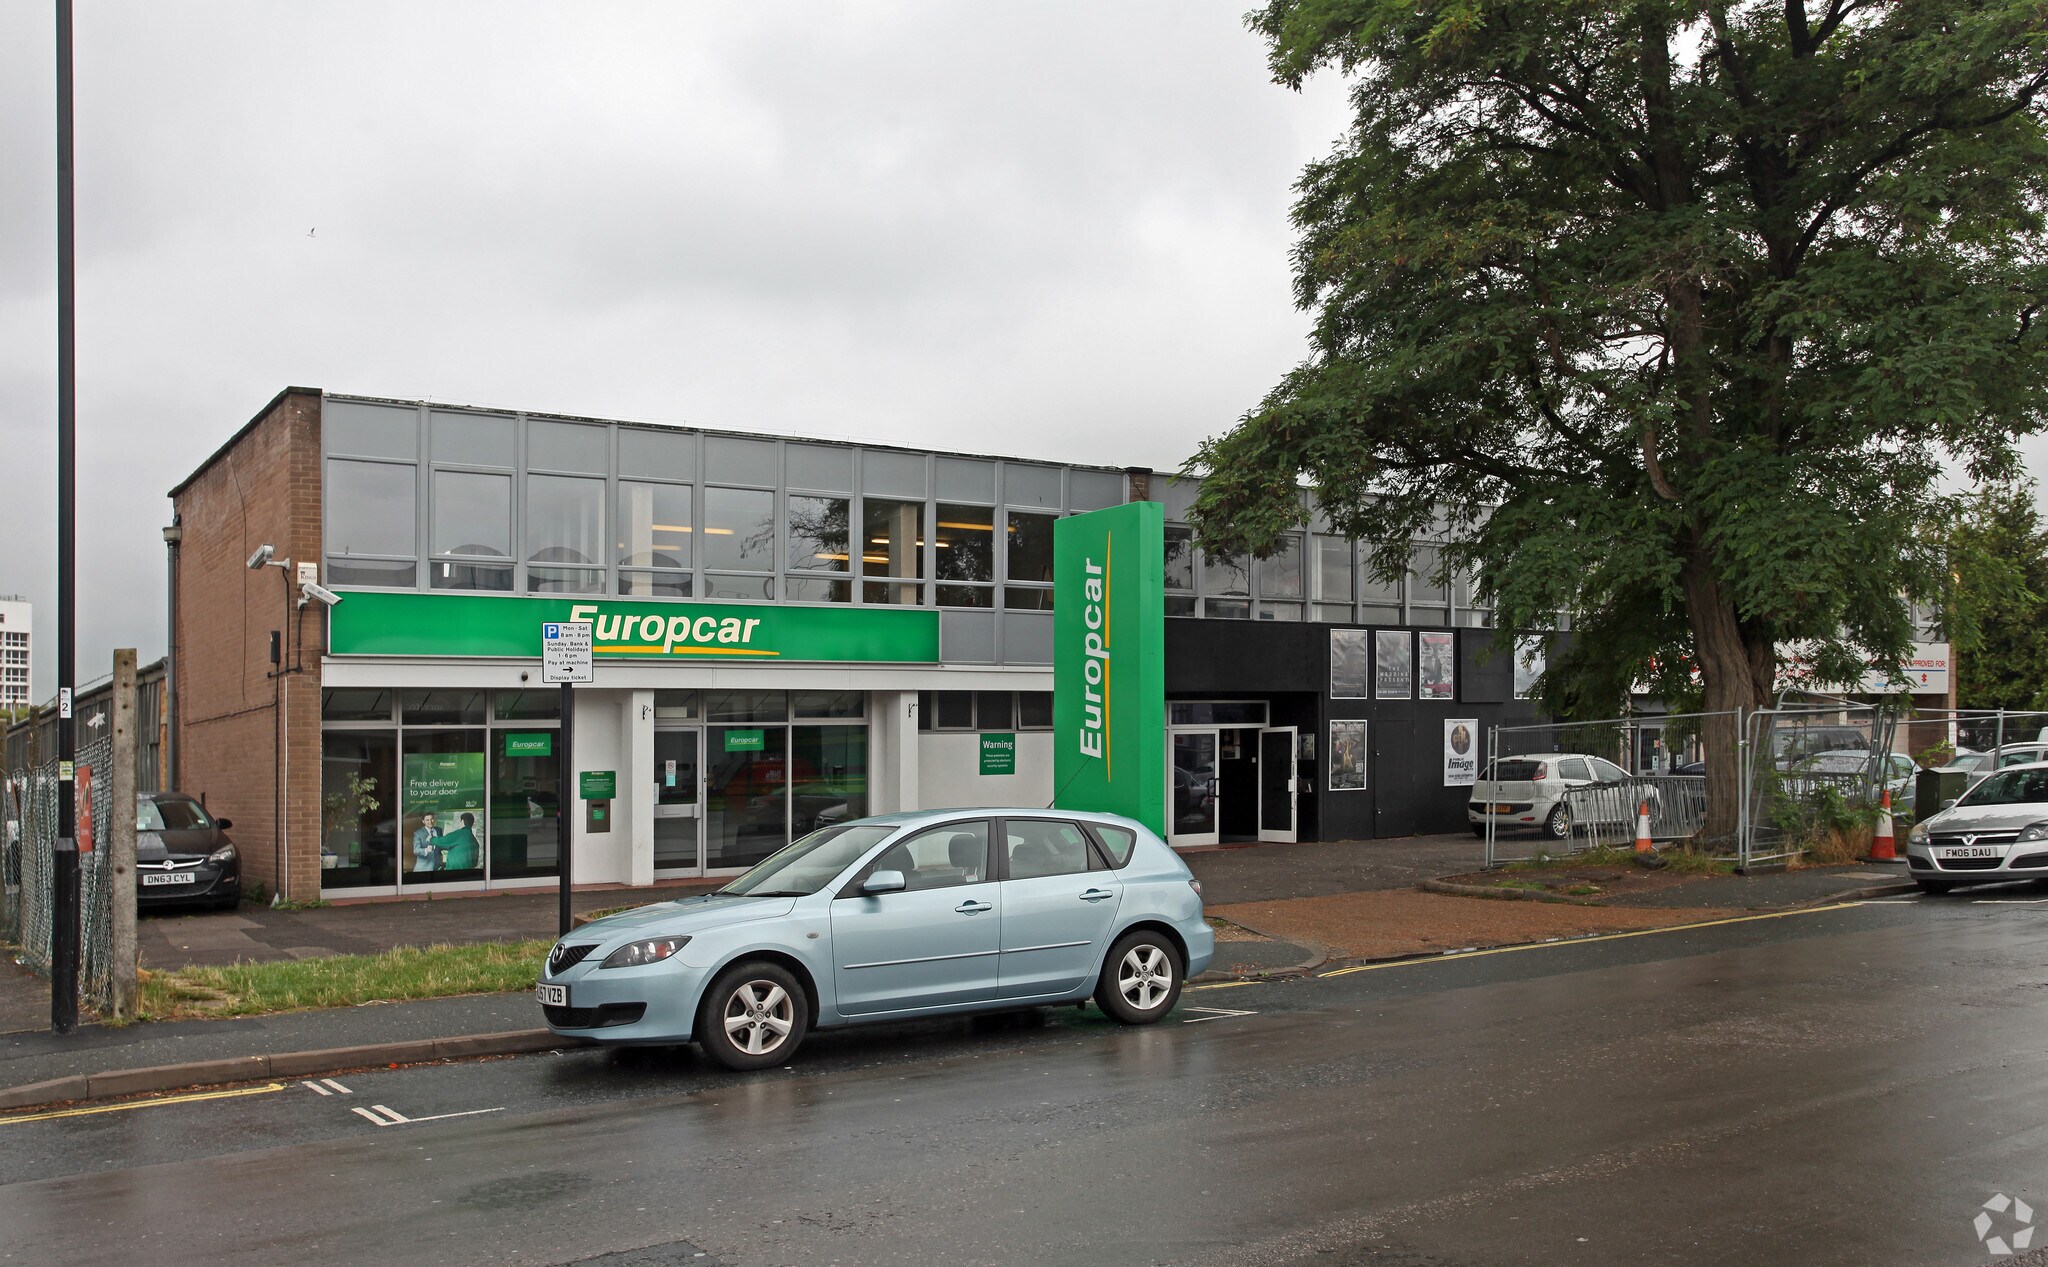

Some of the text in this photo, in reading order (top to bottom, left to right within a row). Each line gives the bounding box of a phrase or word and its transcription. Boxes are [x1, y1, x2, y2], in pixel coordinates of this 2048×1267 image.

[548, 626, 557, 638] P
[570, 605, 760, 653] Europcar
[1080, 558, 1110, 759] Europcar
[62, 703, 68, 711] 2
[512, 741, 545, 749] Europcar
[983, 740, 1013, 750] Warning
[1447, 758, 1474, 771] Image
[410, 779, 459, 789] Free delivery
[1945, 848, 1991, 857] FM06 DAU
[147, 874, 191, 884] DN63 CYL
[547, 987, 562, 1003] VZB
